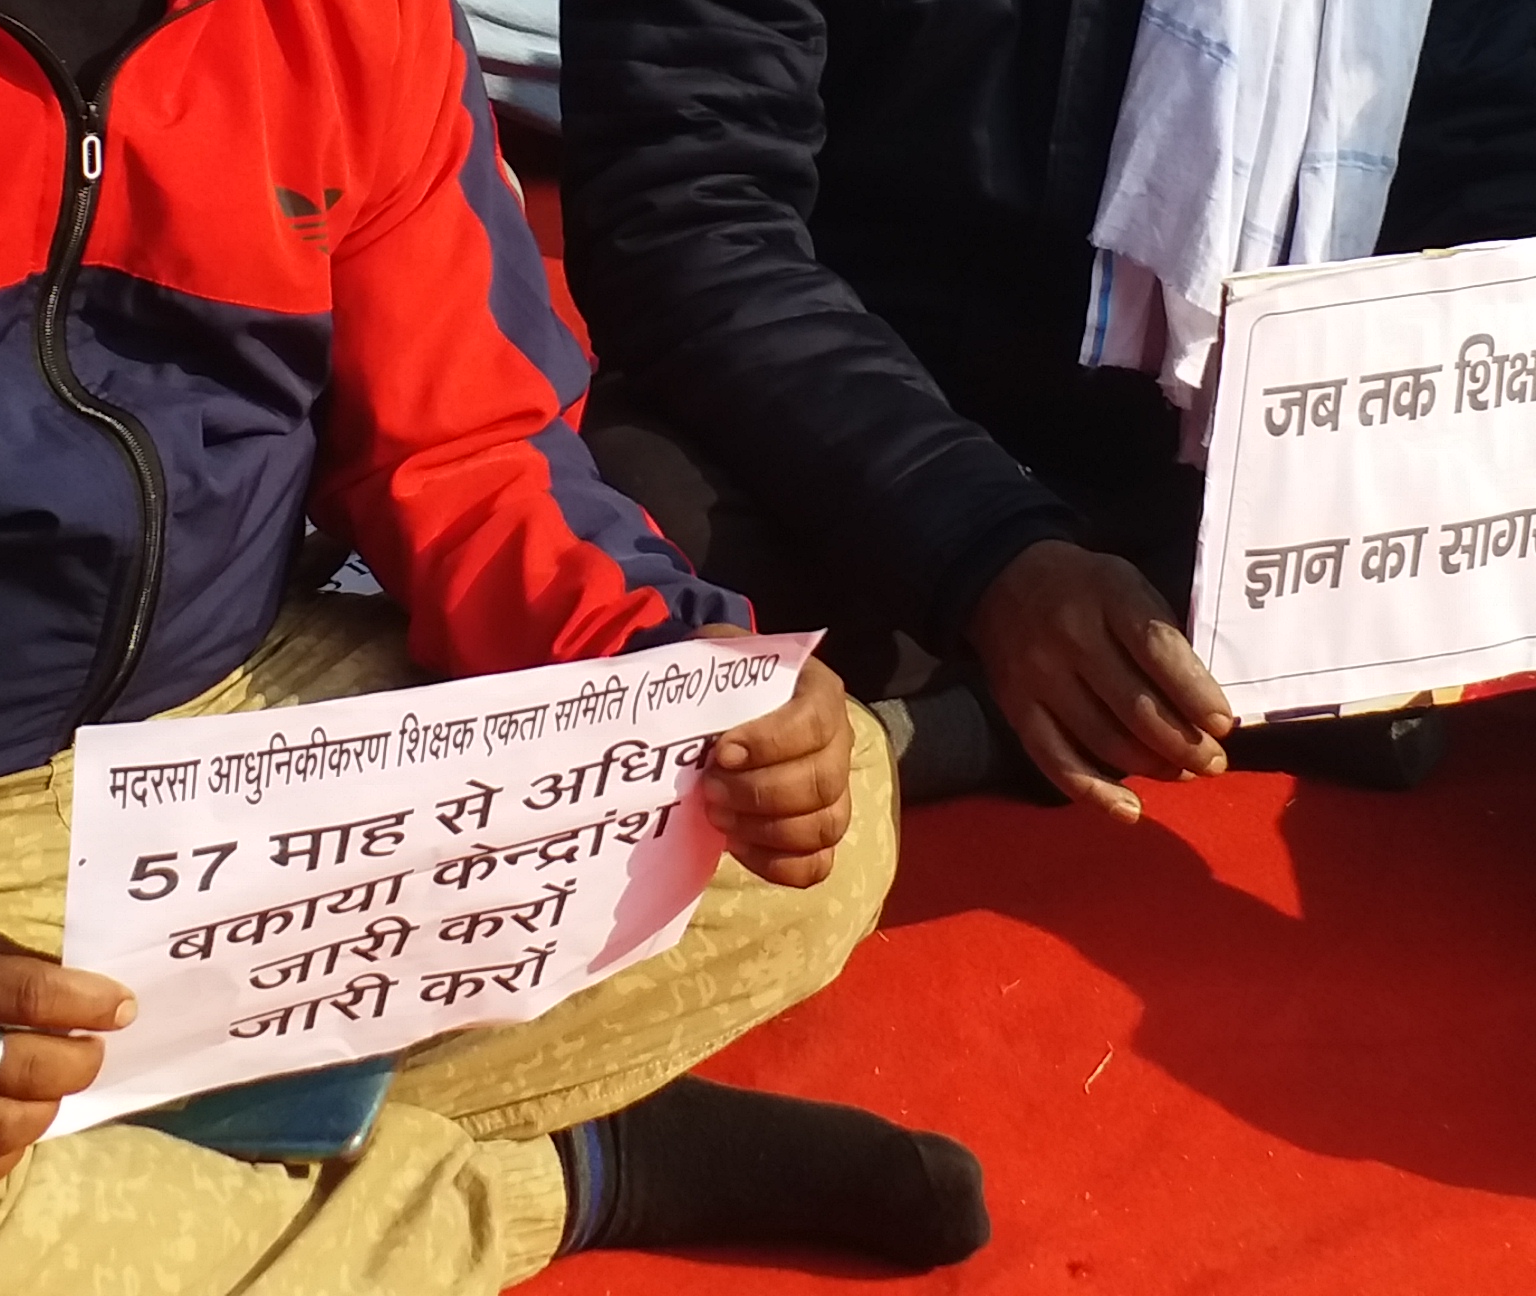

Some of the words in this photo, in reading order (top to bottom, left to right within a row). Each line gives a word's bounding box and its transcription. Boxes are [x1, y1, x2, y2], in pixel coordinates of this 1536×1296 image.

[1263, 378, 1347, 439] जब
[1358, 365, 1444, 426] तक
[1244, 538, 1350, 609] ज्ञान
[1362, 526, 1429, 584] का
[109, 759, 200, 811] मदरसा
[208, 723, 389, 805] आधुनिकीकरण
[396, 713, 477, 767] शिक्षक
[482, 702, 549, 757] एकता
[554, 674, 629, 733] समिति
[127, 842, 237, 902] 57
[270, 808, 414, 873] माह
[435, 779, 504, 837] से
[169, 869, 415, 961] बकाया
[432, 799, 681, 890] केन्द्रांश
[229, 971, 401, 1038] जारी
[420, 940, 557, 1007] करों
[249, 912, 420, 992] जारी
[439, 878, 577, 945] करों
